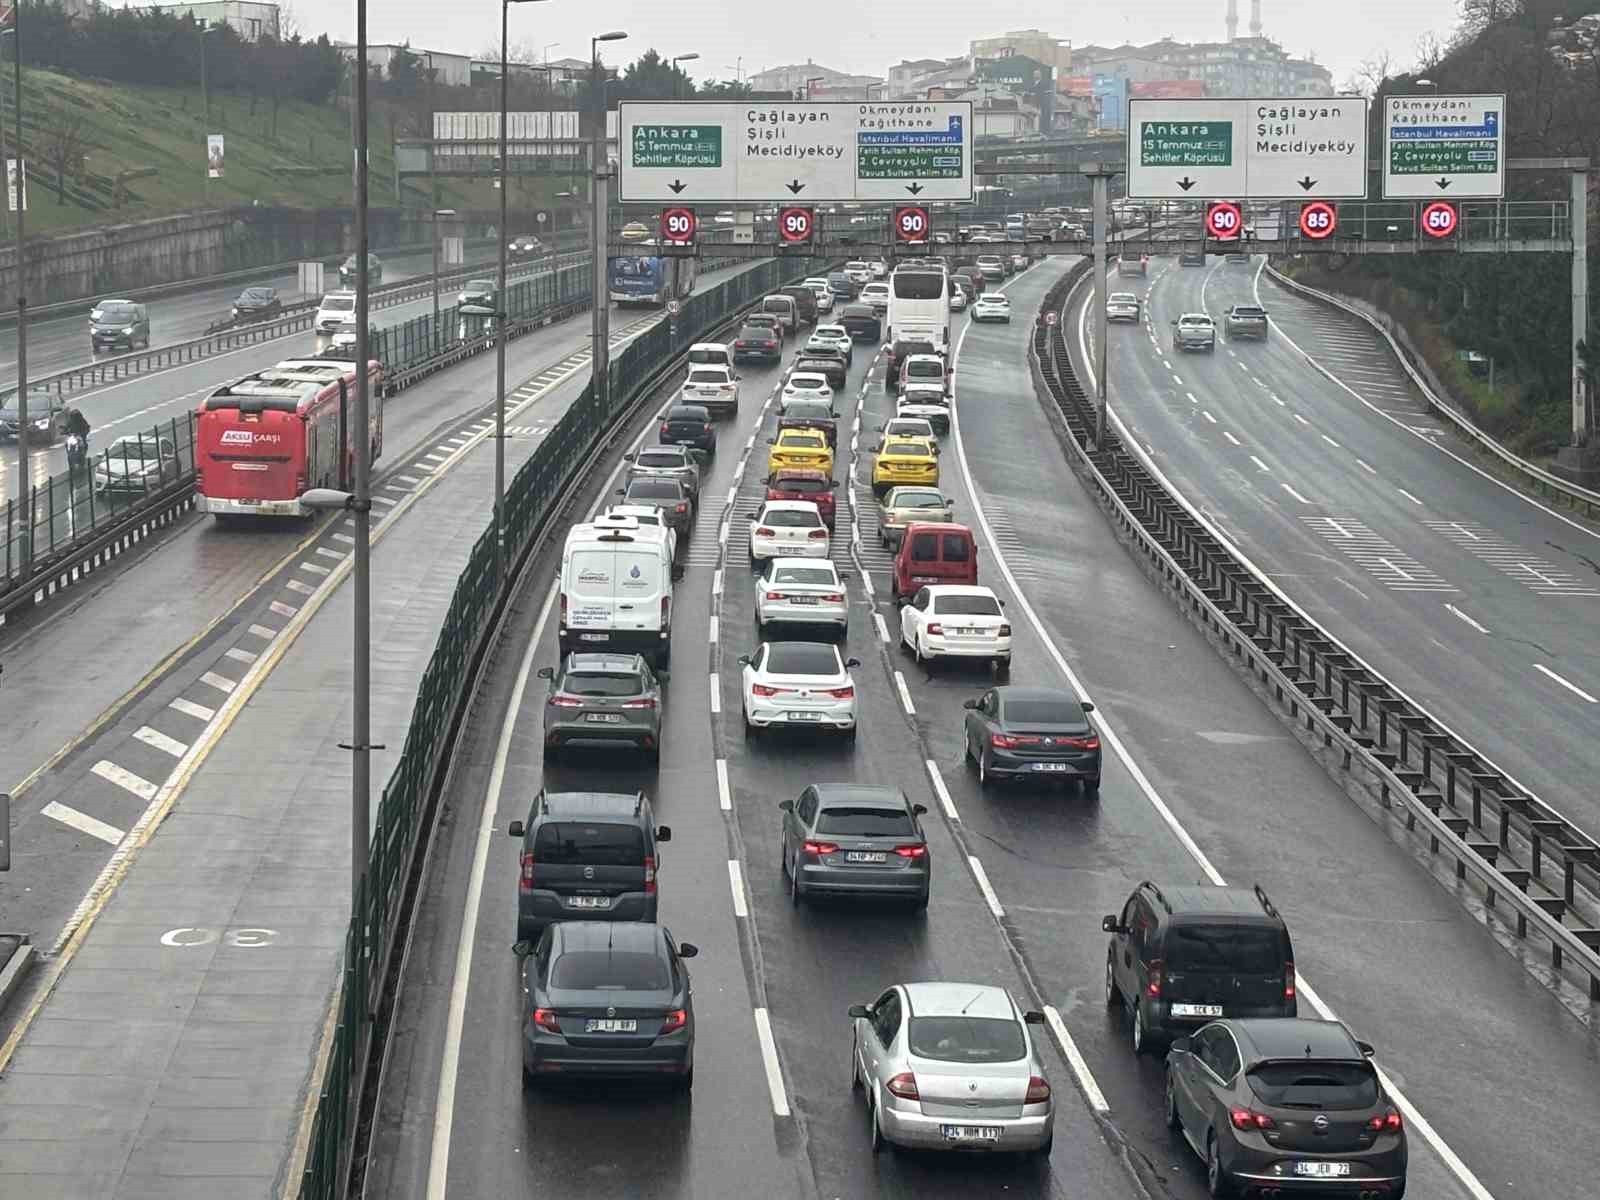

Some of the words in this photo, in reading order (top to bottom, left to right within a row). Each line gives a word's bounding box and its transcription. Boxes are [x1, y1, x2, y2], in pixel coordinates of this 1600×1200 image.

[860, 105, 936, 116] Okmeydanı
[1392, 100, 1471, 110] Okmeydanı
[748, 110, 830, 124] Çağlayan
[1257, 106, 1341, 120] Çağlayan
[1392, 114, 1468, 124] Kağıthane
[860, 119, 932, 129] Kağıthane
[1144, 124, 1208, 135] Ankara
[1257, 124, 1296, 136] Şişli
[636, 127, 698, 138] Ankara
[748, 128, 785, 140] Şişli
[634, 141, 646, 151] 15
[648, 141, 692, 151] Temmuz
[1143, 140, 1154, 149] 15
[1156, 140, 1203, 149] Temmuz
[1257, 141, 1355, 154] Mecidiyeköy
[748, 145, 844, 158] Mecidiyeköy
[1404, 152, 1462, 162] Çevreyolu
[634, 154, 672, 165] Şehitler
[872, 157, 927, 166] Çevreyolu
[1143, 152, 1182, 164] Şehitler
[668, 216, 688, 232] 90
[786, 216, 806, 232] 90
[902, 216, 921, 232] 90
[1214, 213, 1235, 228] 90
[1308, 212, 1328, 228] 85
[1428, 212, 1450, 228] 50
[225, 432, 251, 441] AKSU
[253, 432, 281, 444] ÇARŞI
